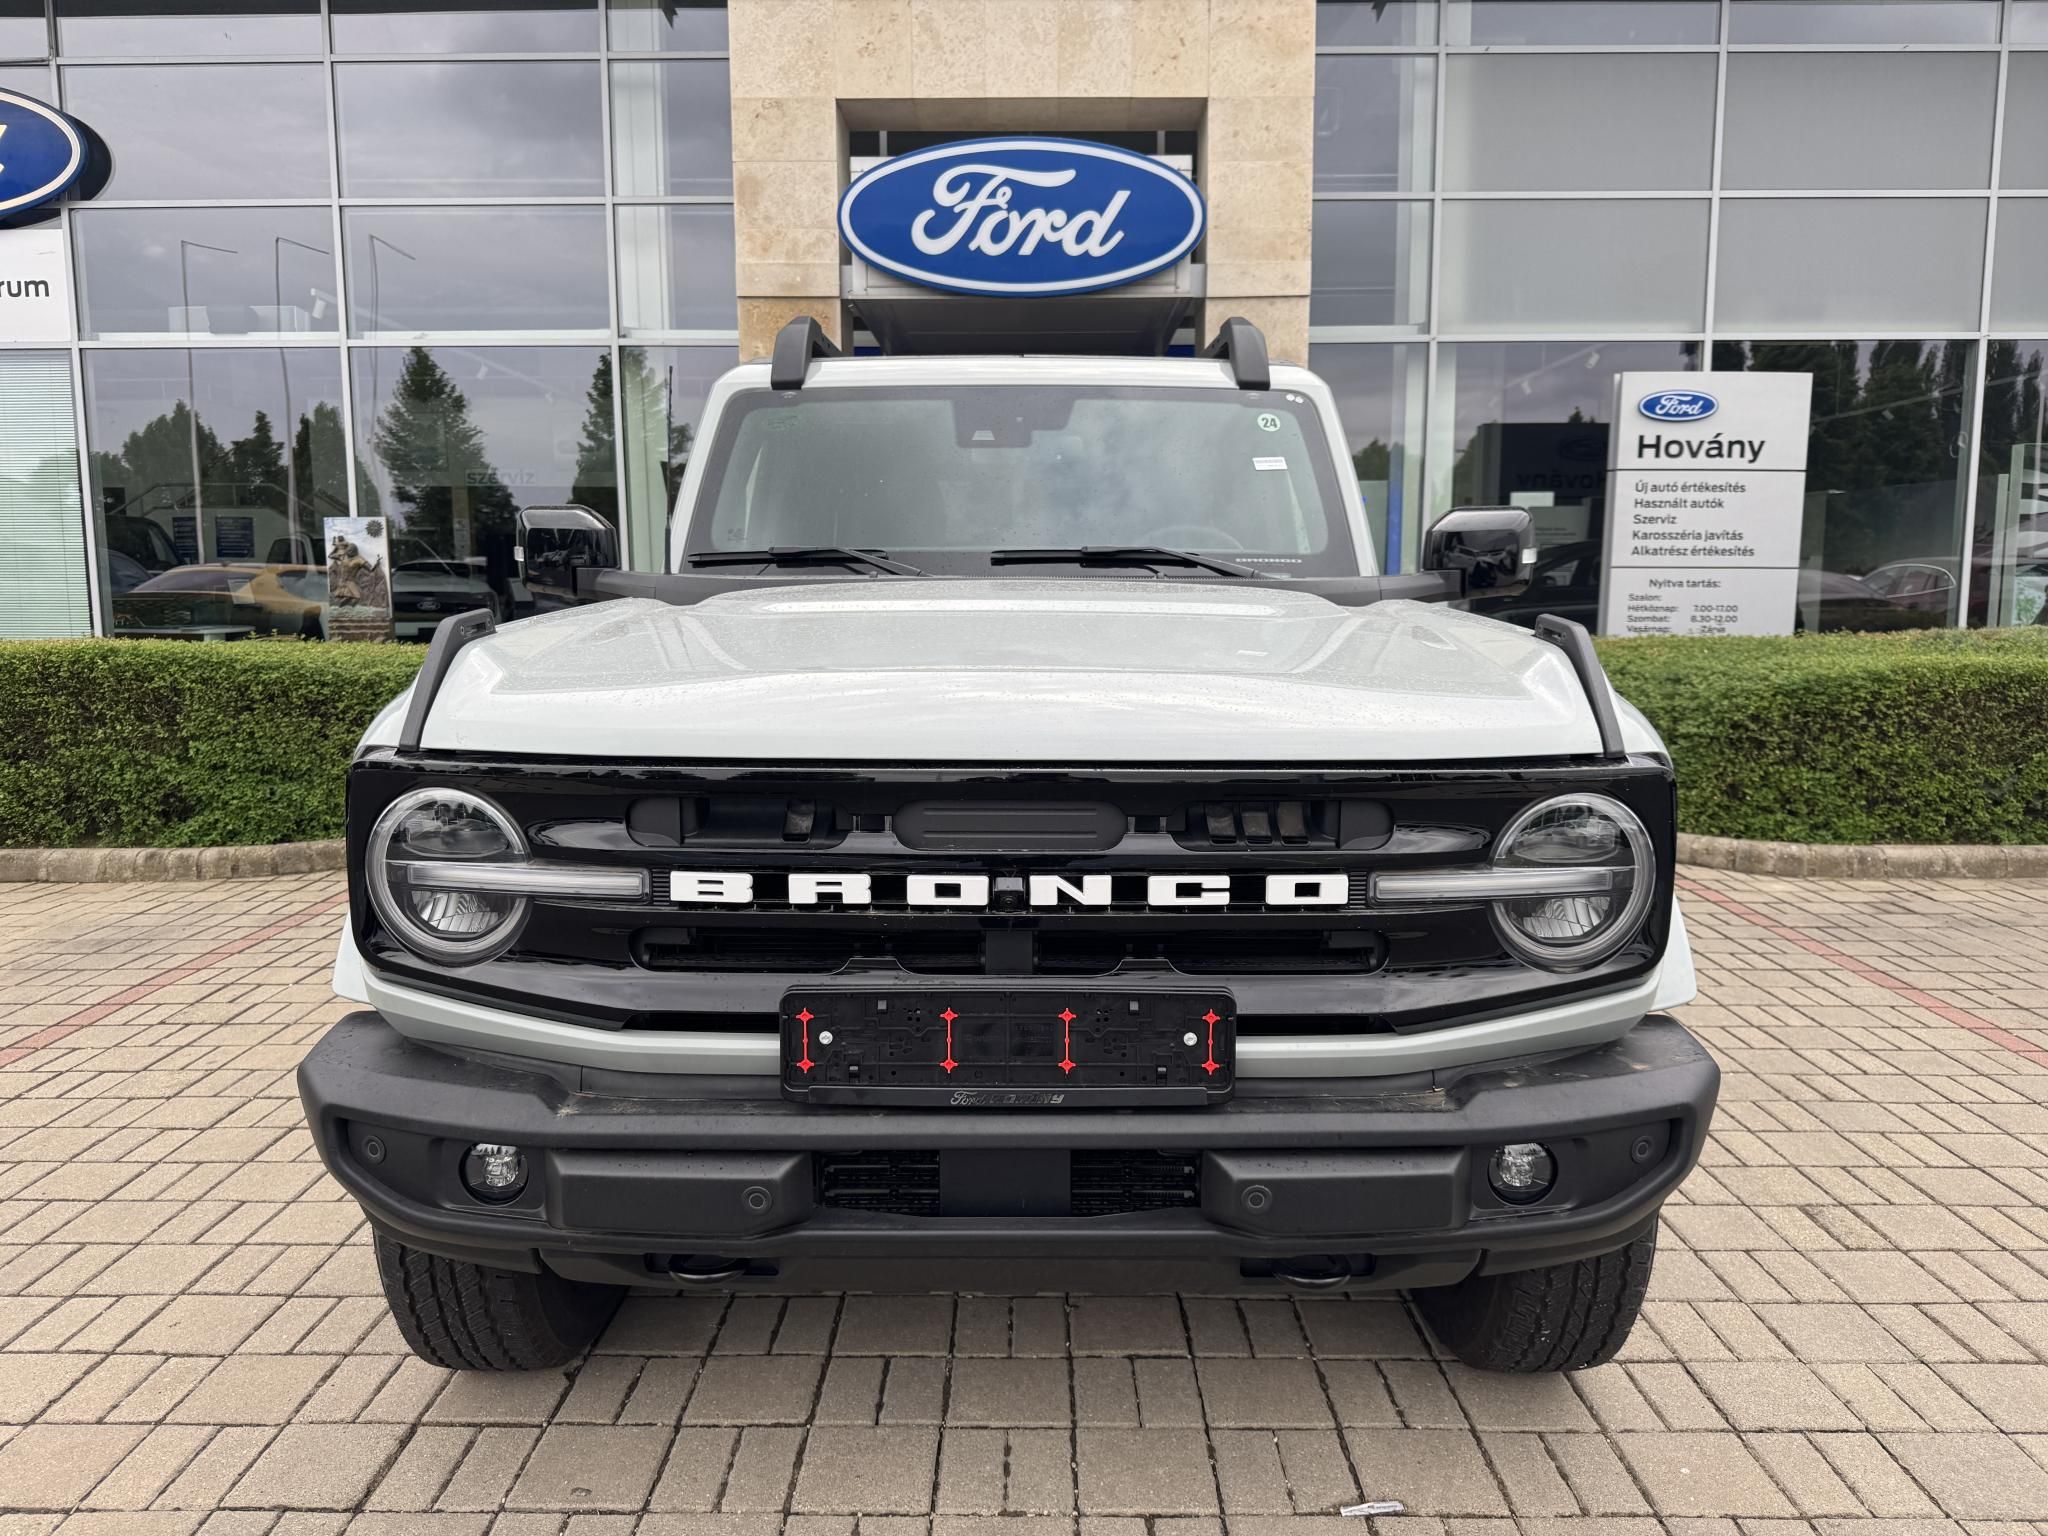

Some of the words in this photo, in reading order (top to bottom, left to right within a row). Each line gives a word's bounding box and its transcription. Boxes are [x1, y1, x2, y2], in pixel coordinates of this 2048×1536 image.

[911, 164, 1131, 257] Ford
[1655, 394, 1704, 415] Ford
[1261, 417, 1278, 428] 24
[1636, 432, 1766, 464] Hovány
[1635, 480, 1649, 494] Új
[1650, 481, 1679, 493] autó
[1680, 481, 1747, 493] értékesítés
[1634, 497, 1688, 509] Használt
[1690, 497, 1725, 509] autók
[1633, 514, 1677, 525] Szerviz
[1632, 529, 1703, 541] Karosszéria
[1704, 529, 1744, 542] javítás
[1631, 545, 1689, 556] Alkatrész
[1690, 545, 1755, 556] értékesítés
[1649, 578, 1685, 589] Nyitva
[670, 870, 1349, 906] BRONCO
